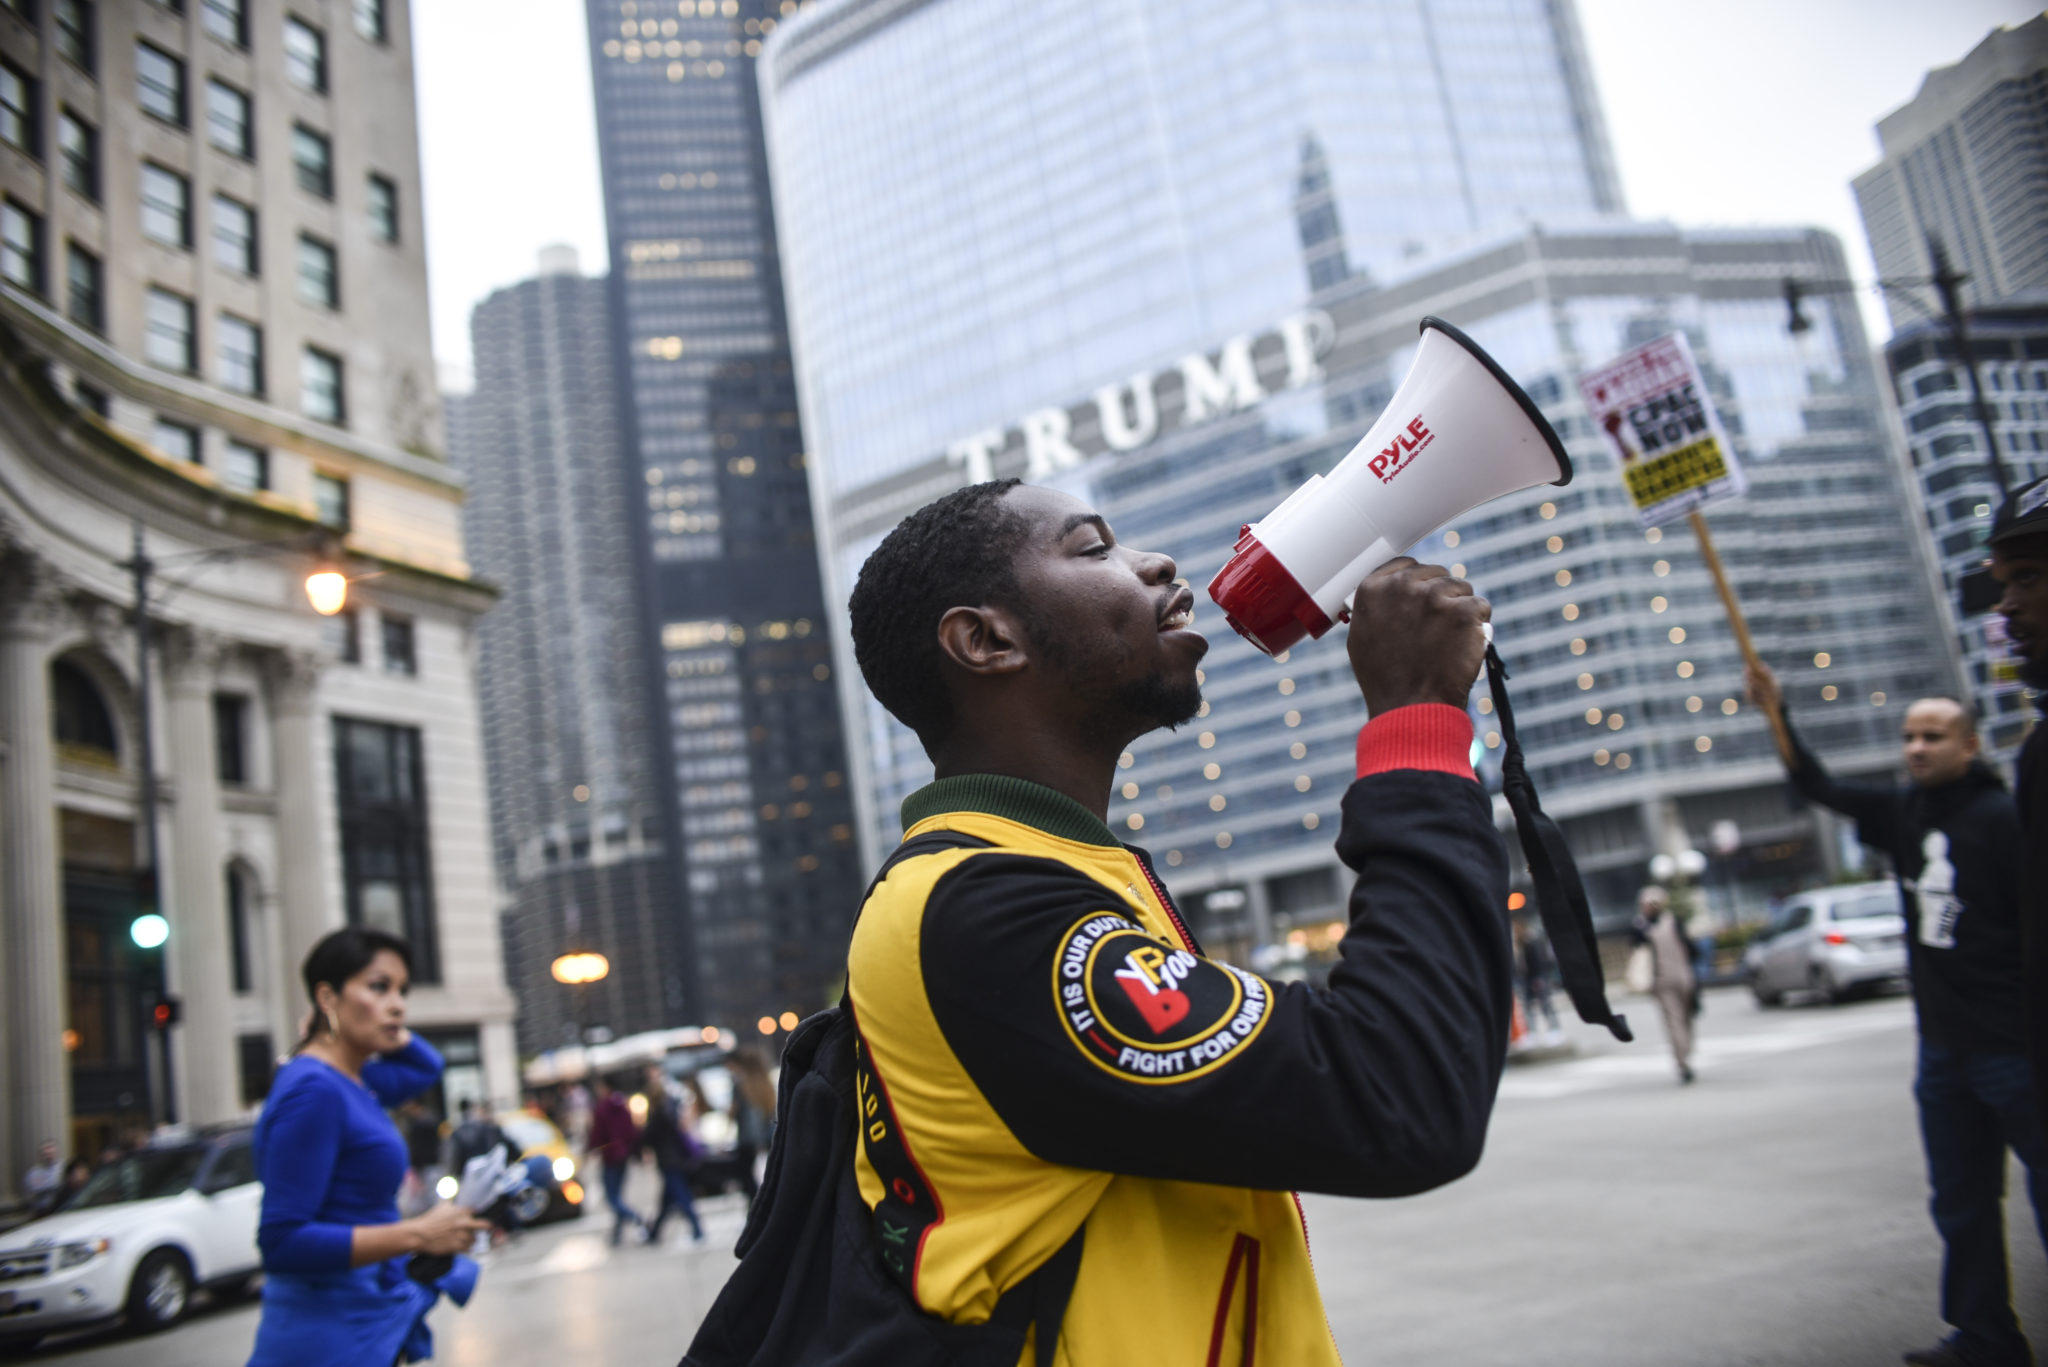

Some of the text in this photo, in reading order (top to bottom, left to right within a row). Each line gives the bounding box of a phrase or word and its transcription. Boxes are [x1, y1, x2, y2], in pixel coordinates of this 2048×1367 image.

[947, 309, 1335, 487] TRUMP
[1640, 411, 1708, 452] NOW
[1368, 414, 1430, 479] PYLE
[1063, 916, 1131, 1032] IT IS OUR DUTY
[1118, 998, 1265, 1074] FIGHT FOR OUR
